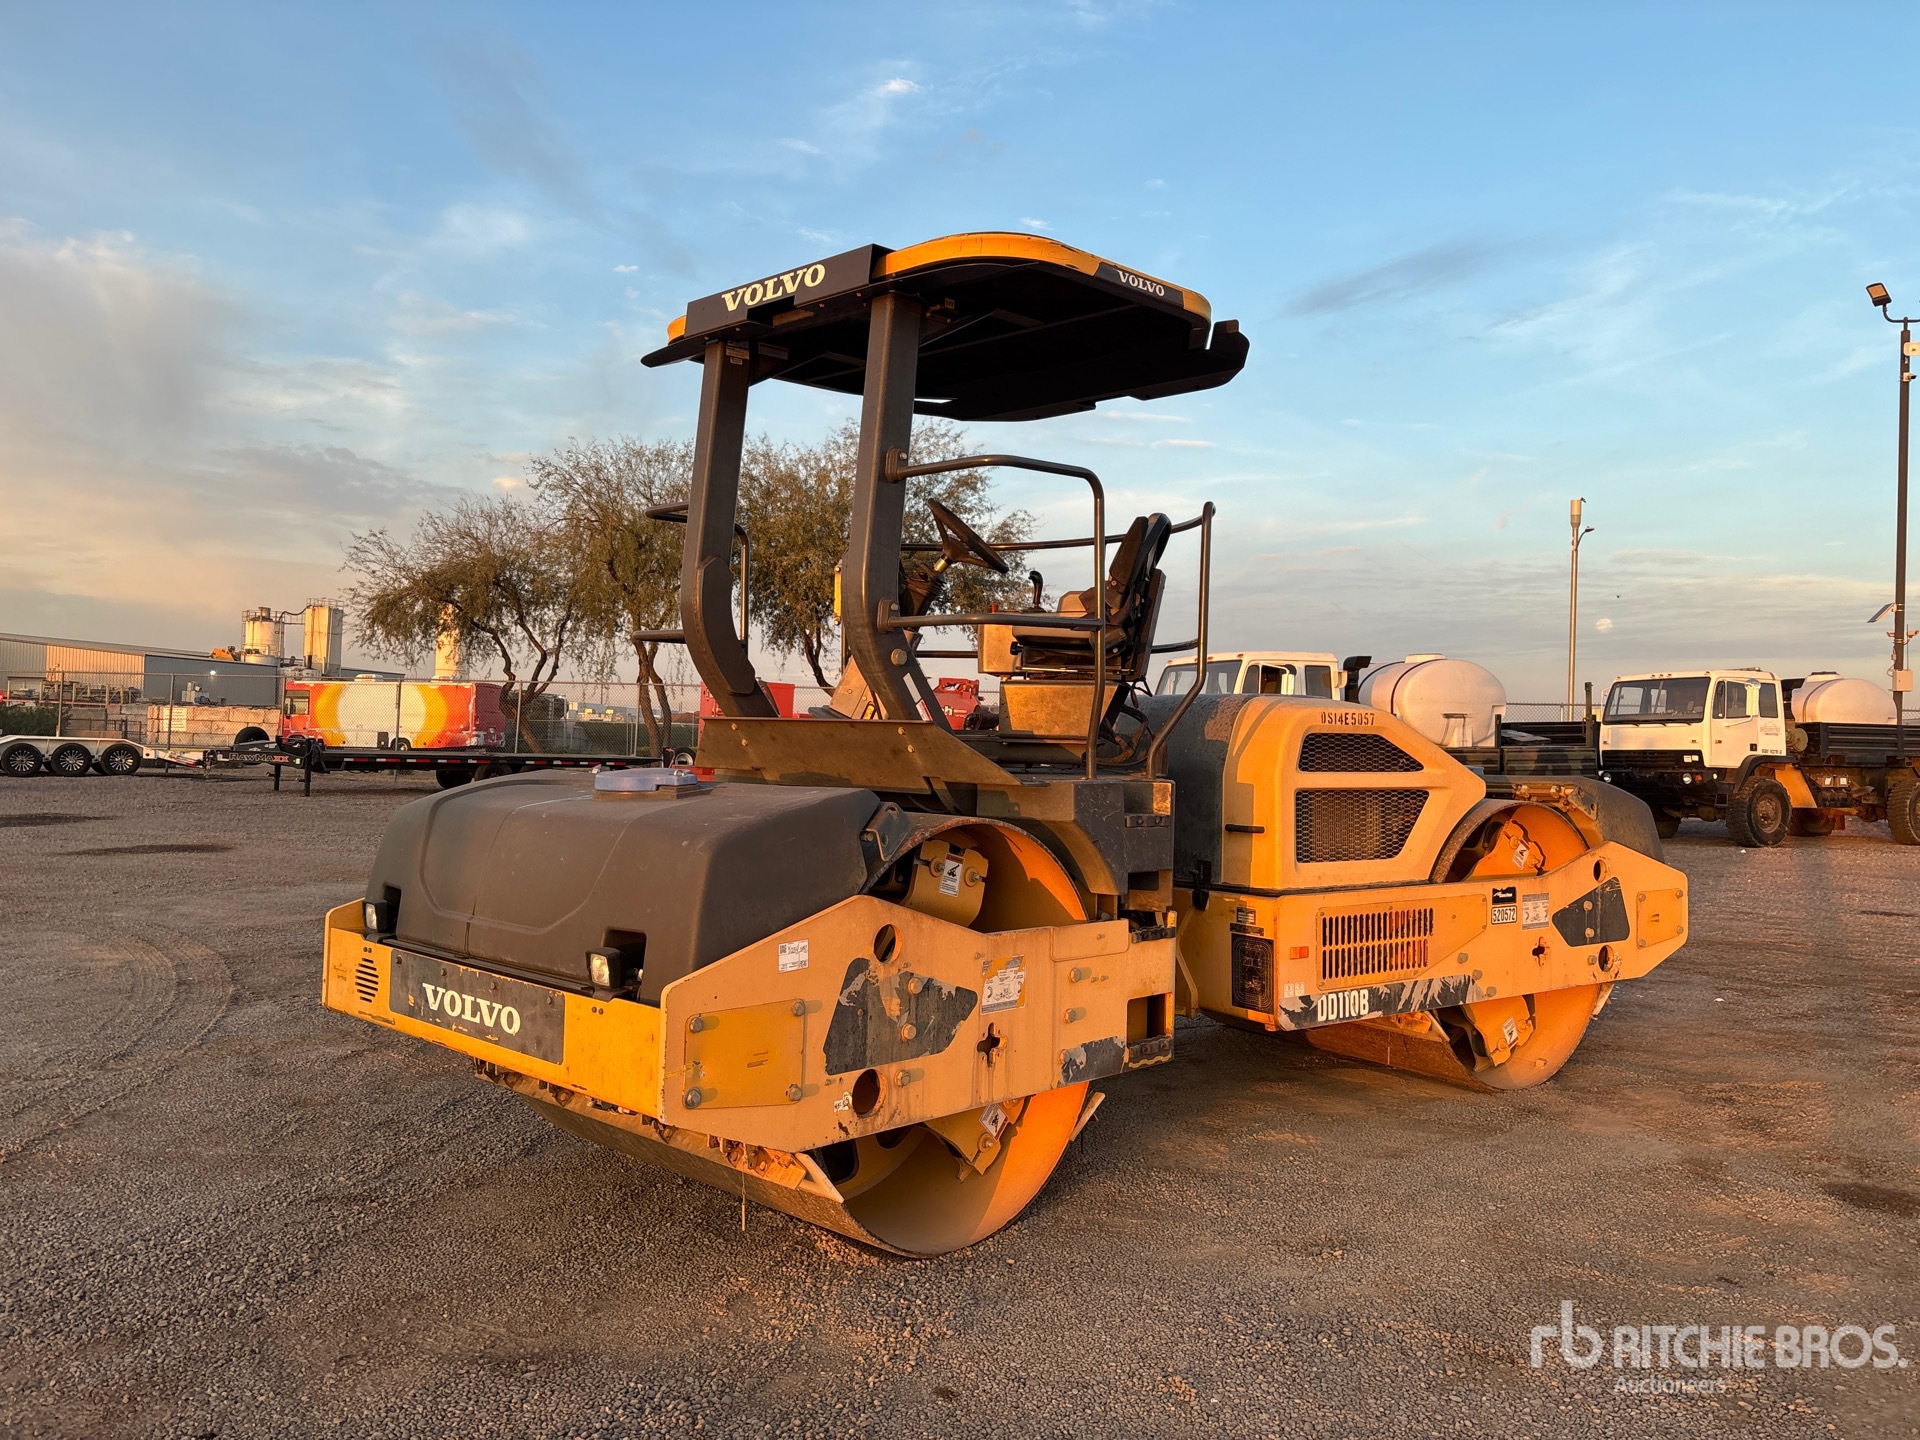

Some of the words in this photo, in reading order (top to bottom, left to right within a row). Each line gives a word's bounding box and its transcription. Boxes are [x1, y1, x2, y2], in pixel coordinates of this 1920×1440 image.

[721, 263, 826, 312] VOLVO
[1117, 269, 1165, 297] VOLVO
[1492, 907, 1516, 923] 520572
[422, 982, 521, 1036] VOLVO
[1317, 988, 1369, 1022] DD110B
